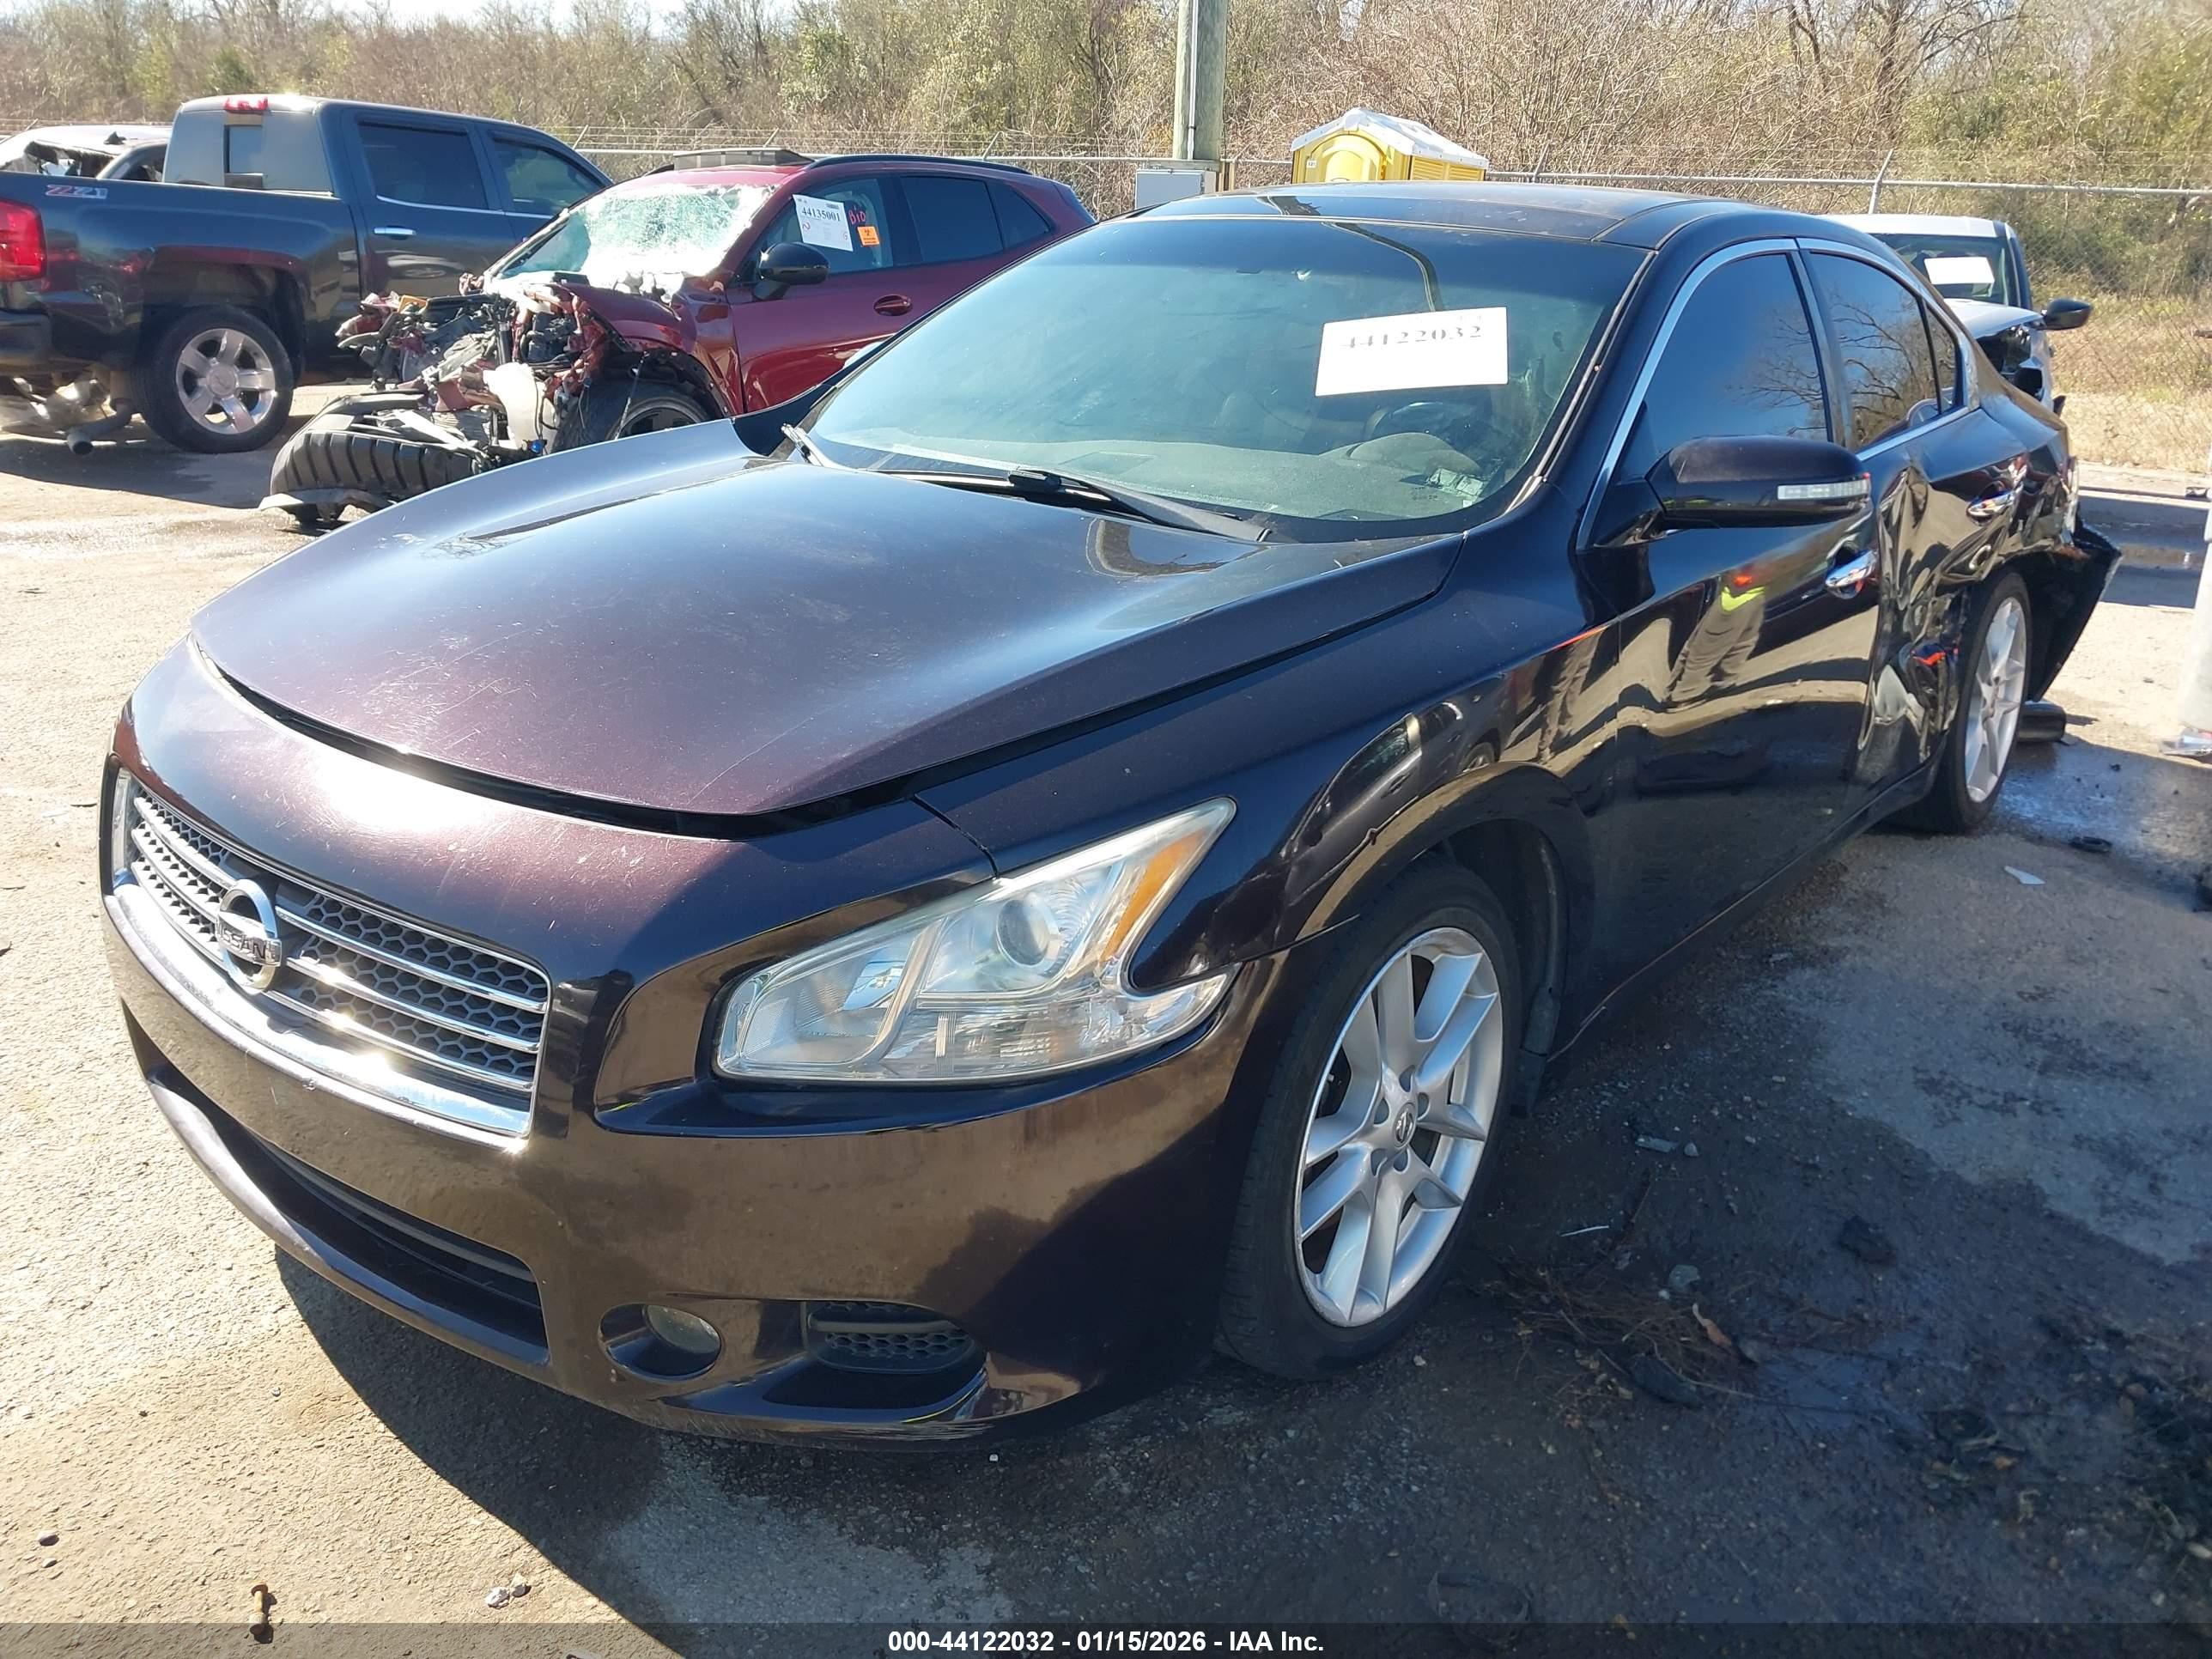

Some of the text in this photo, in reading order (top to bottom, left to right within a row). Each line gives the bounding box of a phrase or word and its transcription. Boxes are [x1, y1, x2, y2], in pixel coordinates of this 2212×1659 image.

[801, 206, 841, 222] 44135001
[1340, 325, 1481, 349] 44122032
[216, 915, 267, 961] NISSAN
